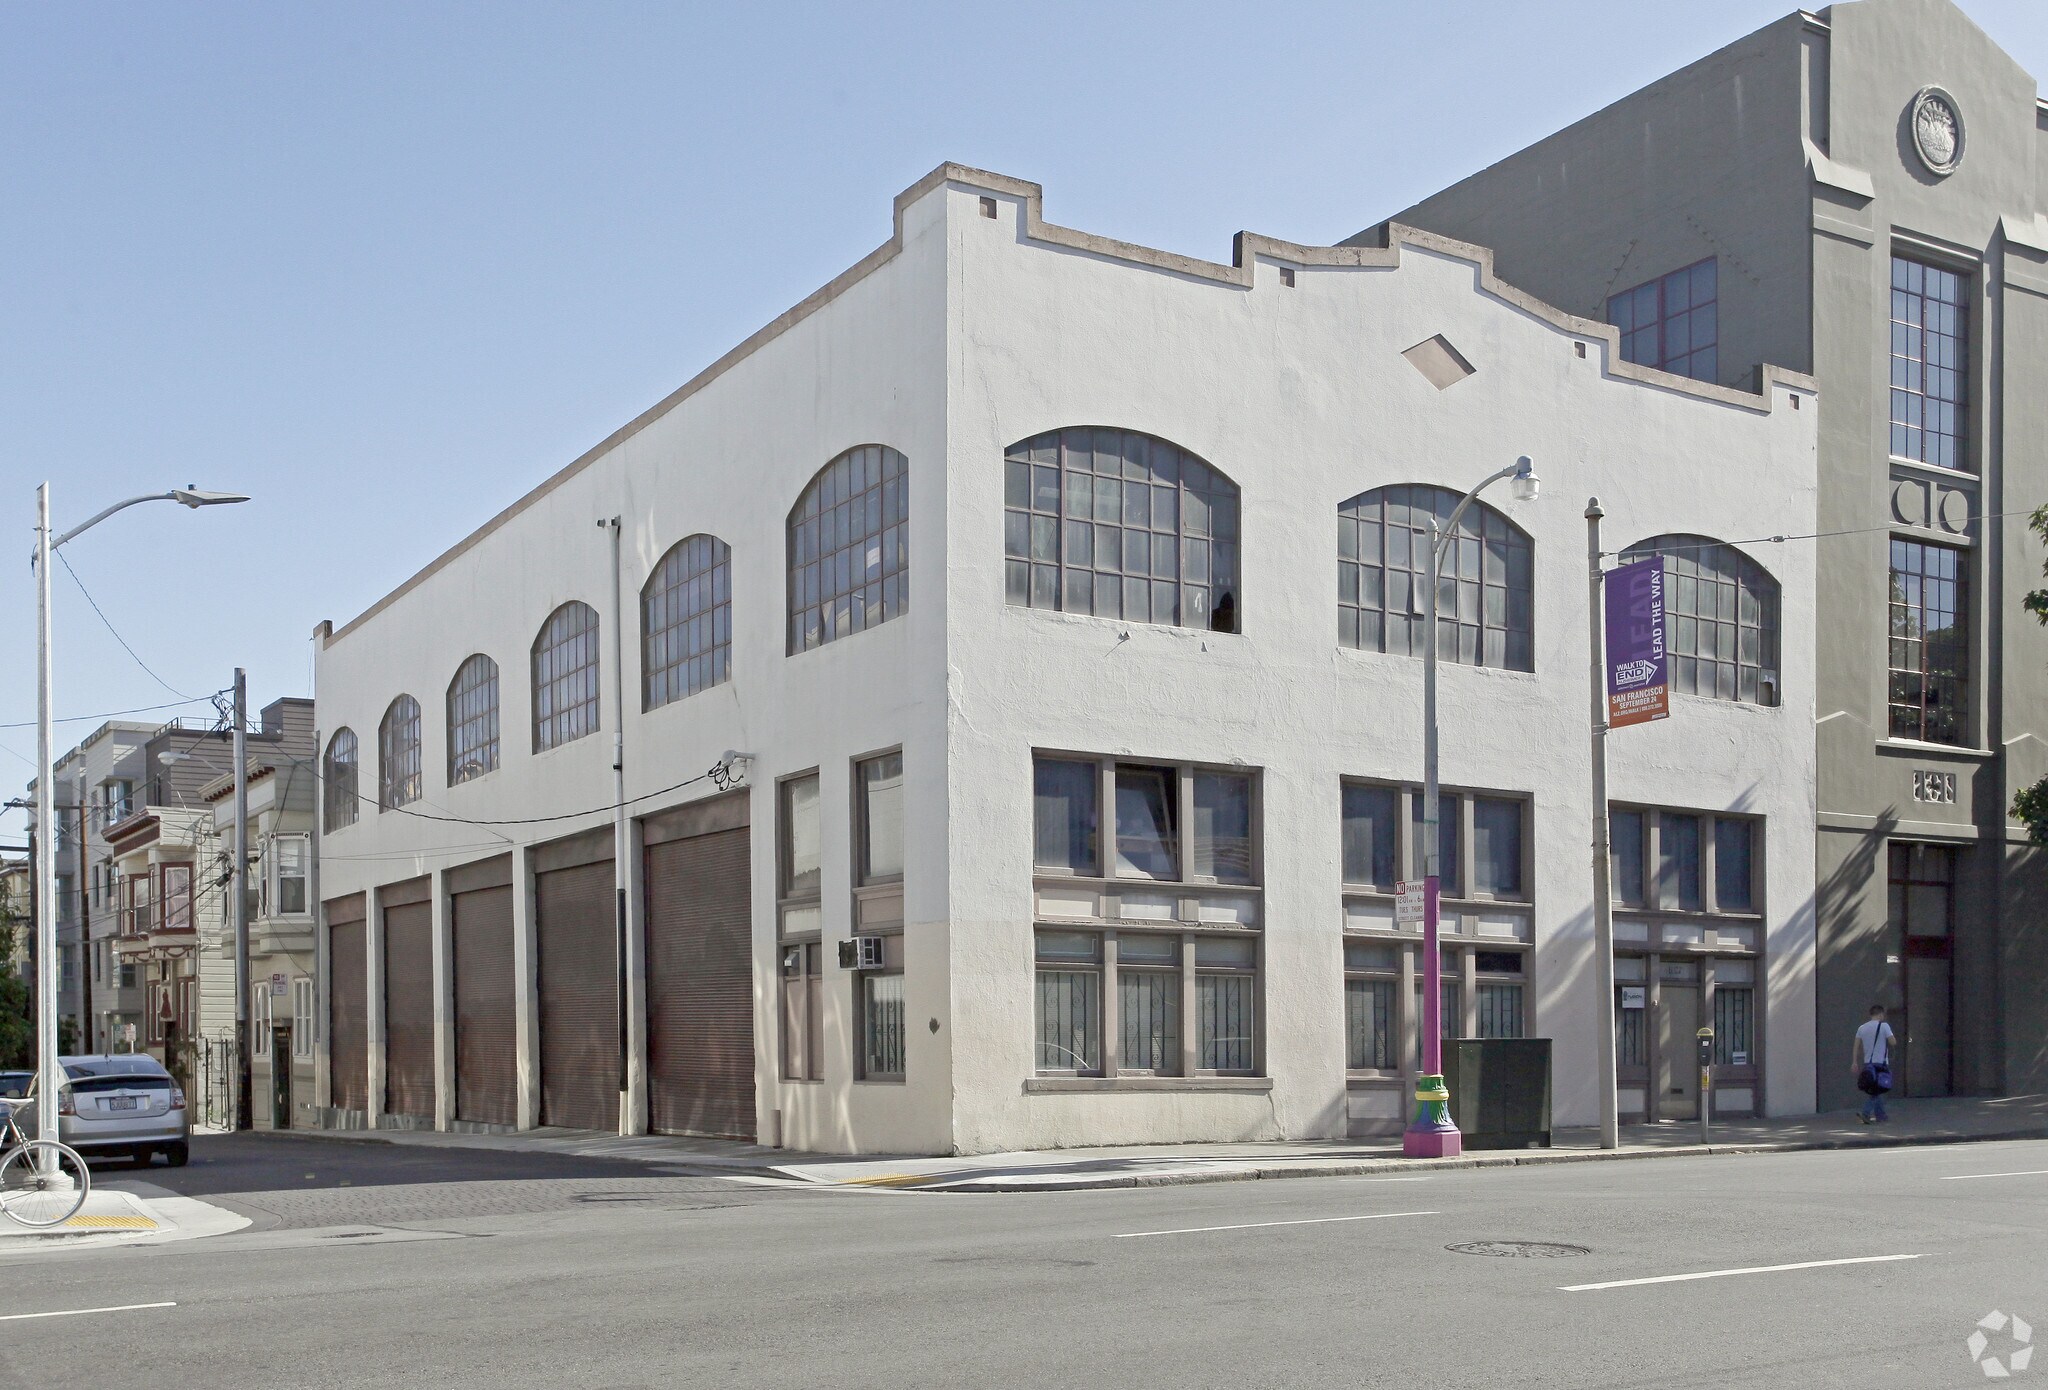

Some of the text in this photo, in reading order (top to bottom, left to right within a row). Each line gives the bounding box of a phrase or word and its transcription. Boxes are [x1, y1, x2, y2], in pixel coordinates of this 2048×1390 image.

[1651, 569, 1663, 660] LEAD THE WAY
[1616, 659, 1644, 671] WALK TO
[1617, 669, 1644, 681] END
[1612, 694, 1626, 704] SAN
[1627, 685, 1663, 700] FRANCISCO
[1619, 697, 1650, 710] SEPTEMBER
[1397, 884, 1405, 894] NO
